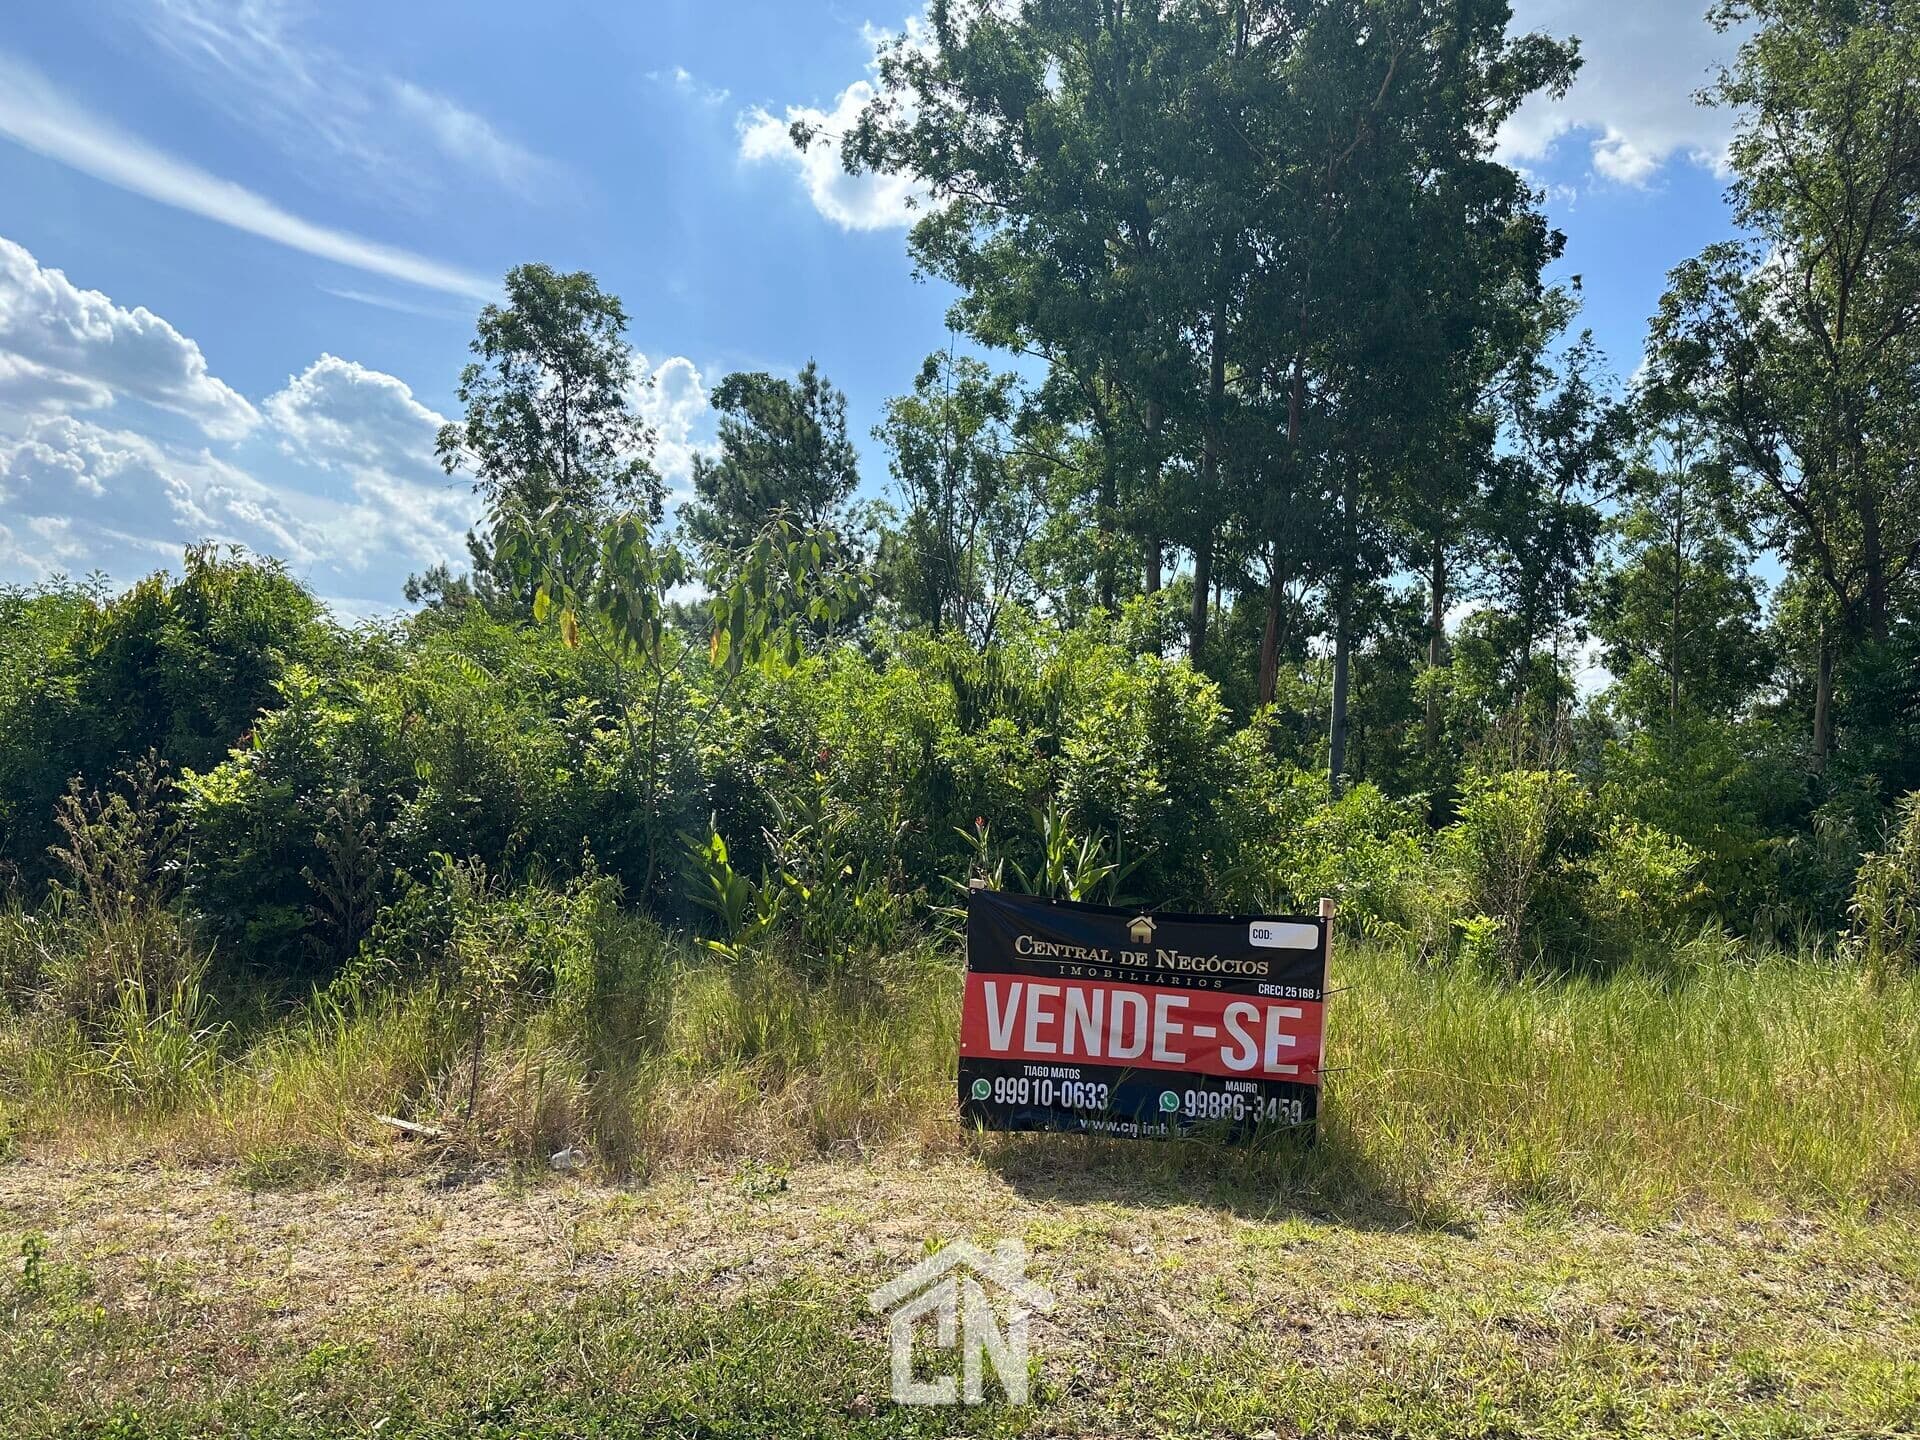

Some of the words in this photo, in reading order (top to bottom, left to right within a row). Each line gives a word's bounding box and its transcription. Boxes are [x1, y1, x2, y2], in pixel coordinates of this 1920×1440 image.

[1252, 927, 1273, 941] COD:
[1014, 935, 1113, 964] CENTRAL
[1120, 950, 1148, 967] DE
[1155, 949, 1270, 976] NEGÓCIOS
[1058, 964, 1223, 989] IMOBILIÁRIOS
[1258, 983, 1284, 996] CRECI
[1285, 986, 1314, 999] 25168
[983, 981, 1303, 1075] VENDE-SE
[1023, 1065, 1049, 1078] TIAGO
[1050, 1066, 1081, 1080] MATOS
[994, 1077, 1109, 1111] 99910-0633
[1225, 1080, 1258, 1094] MAURO
[1184, 1089, 1303, 1125] 99886-3459
